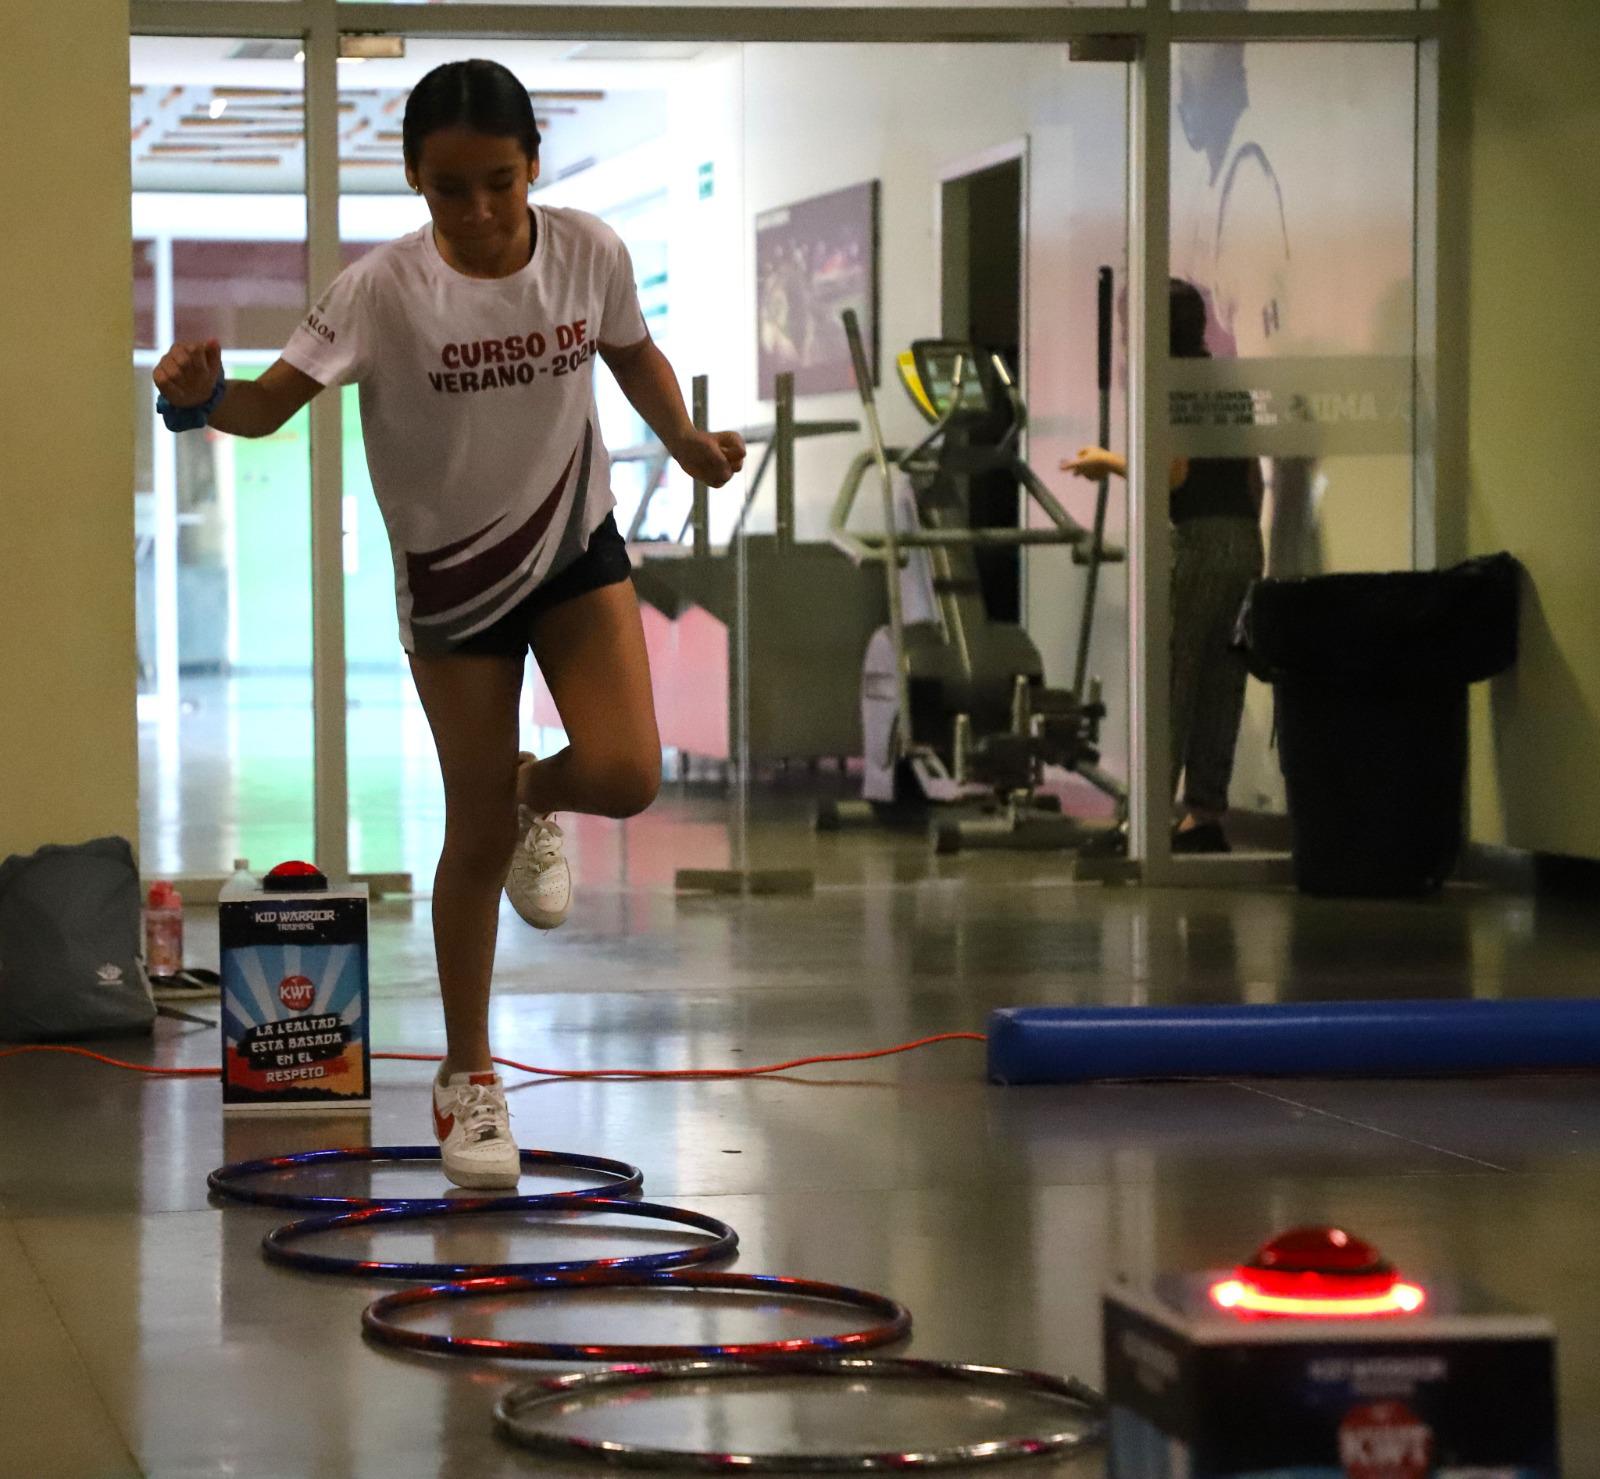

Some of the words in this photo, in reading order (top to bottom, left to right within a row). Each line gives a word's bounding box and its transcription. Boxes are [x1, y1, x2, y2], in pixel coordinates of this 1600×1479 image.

[441, 332, 546, 370] CURSO
[555, 319, 587, 351] DE
[428, 362, 535, 393] VERANO
[255, 911, 277, 923] KID
[279, 910, 336, 923] WARRIOR
[280, 985, 313, 1000] KWT
[256, 1025, 274, 1037] LA
[277, 1017, 337, 1035] LEALTAD
[251, 1040, 285, 1053] ESTA
[288, 1032, 343, 1049] BASADA
[276, 1054, 294, 1066] EN
[298, 1052, 314, 1063] EL
